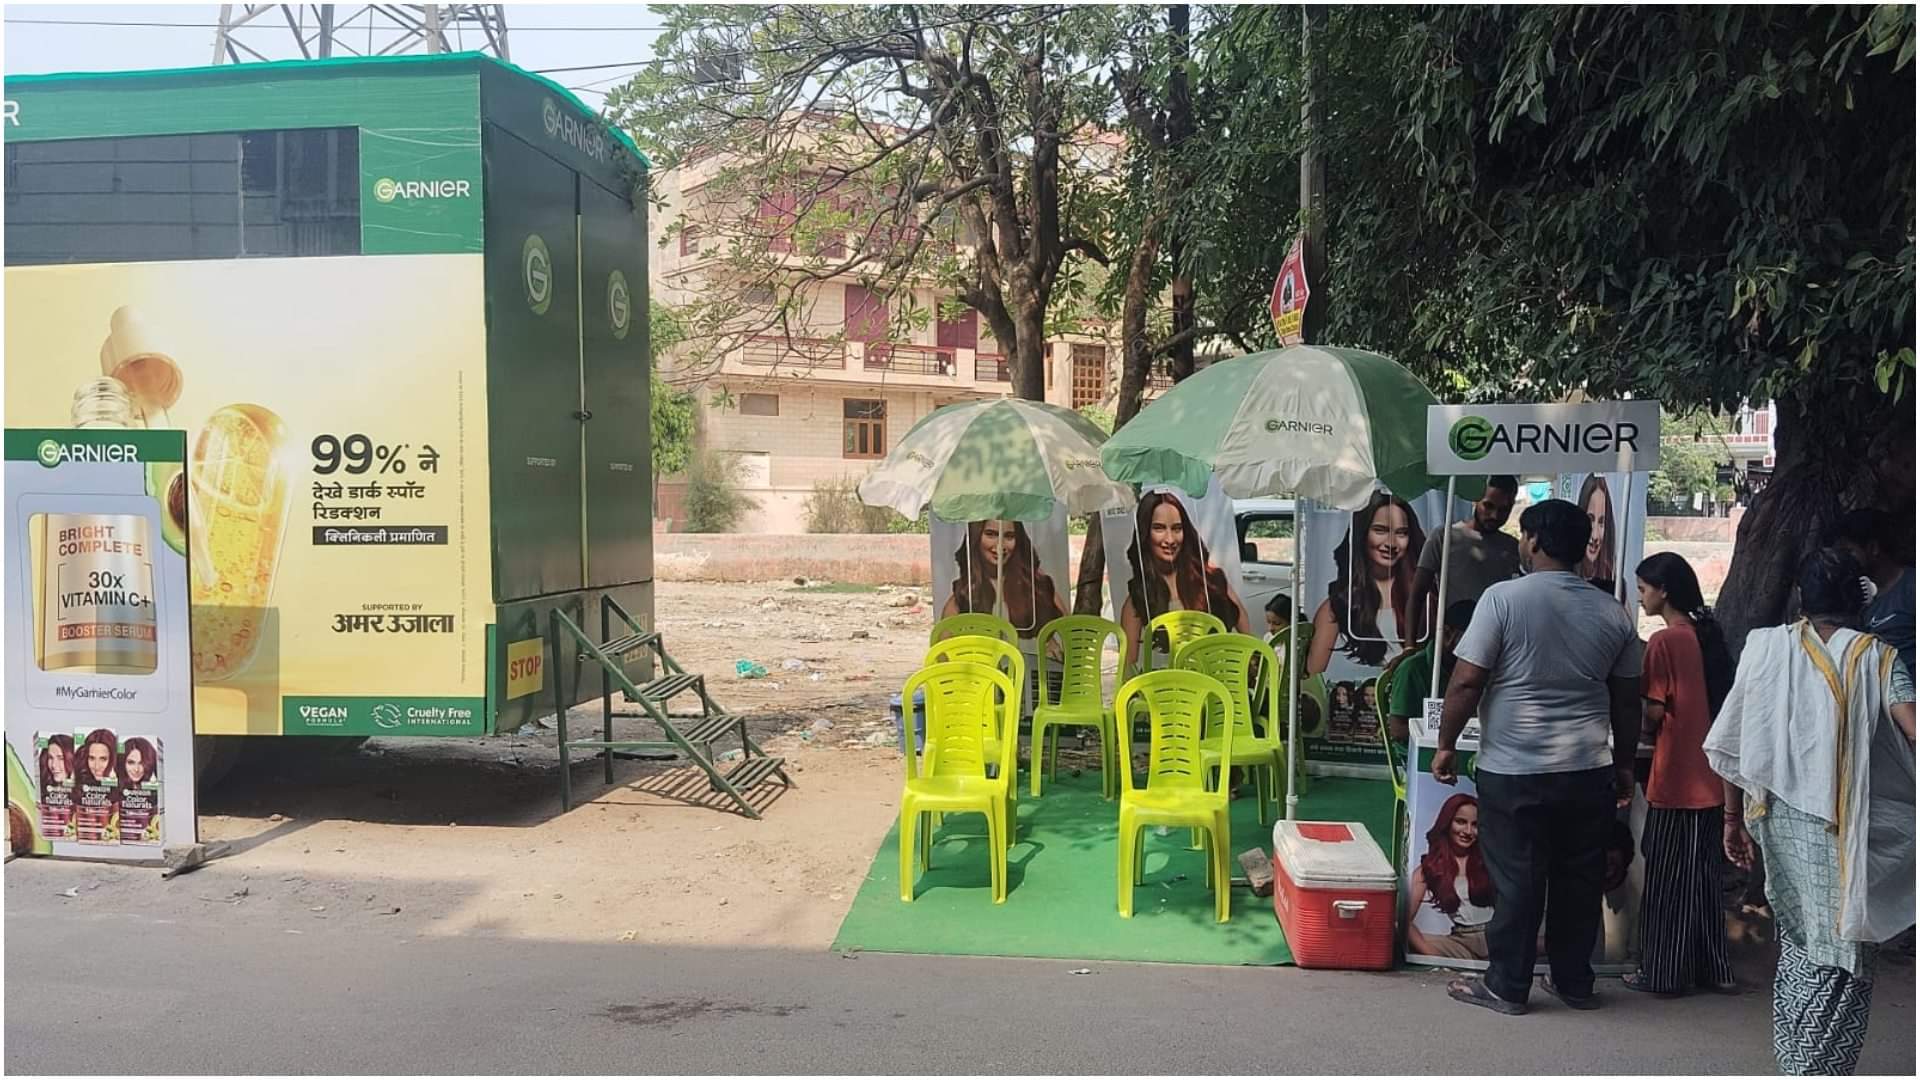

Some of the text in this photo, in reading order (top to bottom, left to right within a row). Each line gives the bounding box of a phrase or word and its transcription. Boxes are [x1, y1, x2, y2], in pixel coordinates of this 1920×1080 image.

[375, 178, 470, 201] GARNIER
[1266, 419, 1334, 436] GARNIER
[1451, 418, 1639, 457] GARNIER
[39, 441, 138, 465] GARNIER
[417, 444, 440, 474] ने
[312, 480, 425, 500] देखे डार्क स्पॉट
[312, 501, 382, 520] रिडक्शन
[59, 526, 115, 542] BRIGHT
[389, 528, 436, 543] प्रमाणित
[58, 541, 143, 556] COMPLETE
[61, 591, 151, 608] VITAMIN C+
[362, 603, 423, 611] SUPPORTED BY
[62, 624, 153, 639] BOOSTER SERUM
[331, 614, 455, 633] अमर उजाला
[510, 655, 541, 680] STOP
[299, 705, 347, 718] VEGAN
[407, 706, 472, 720] Cruelty Free
